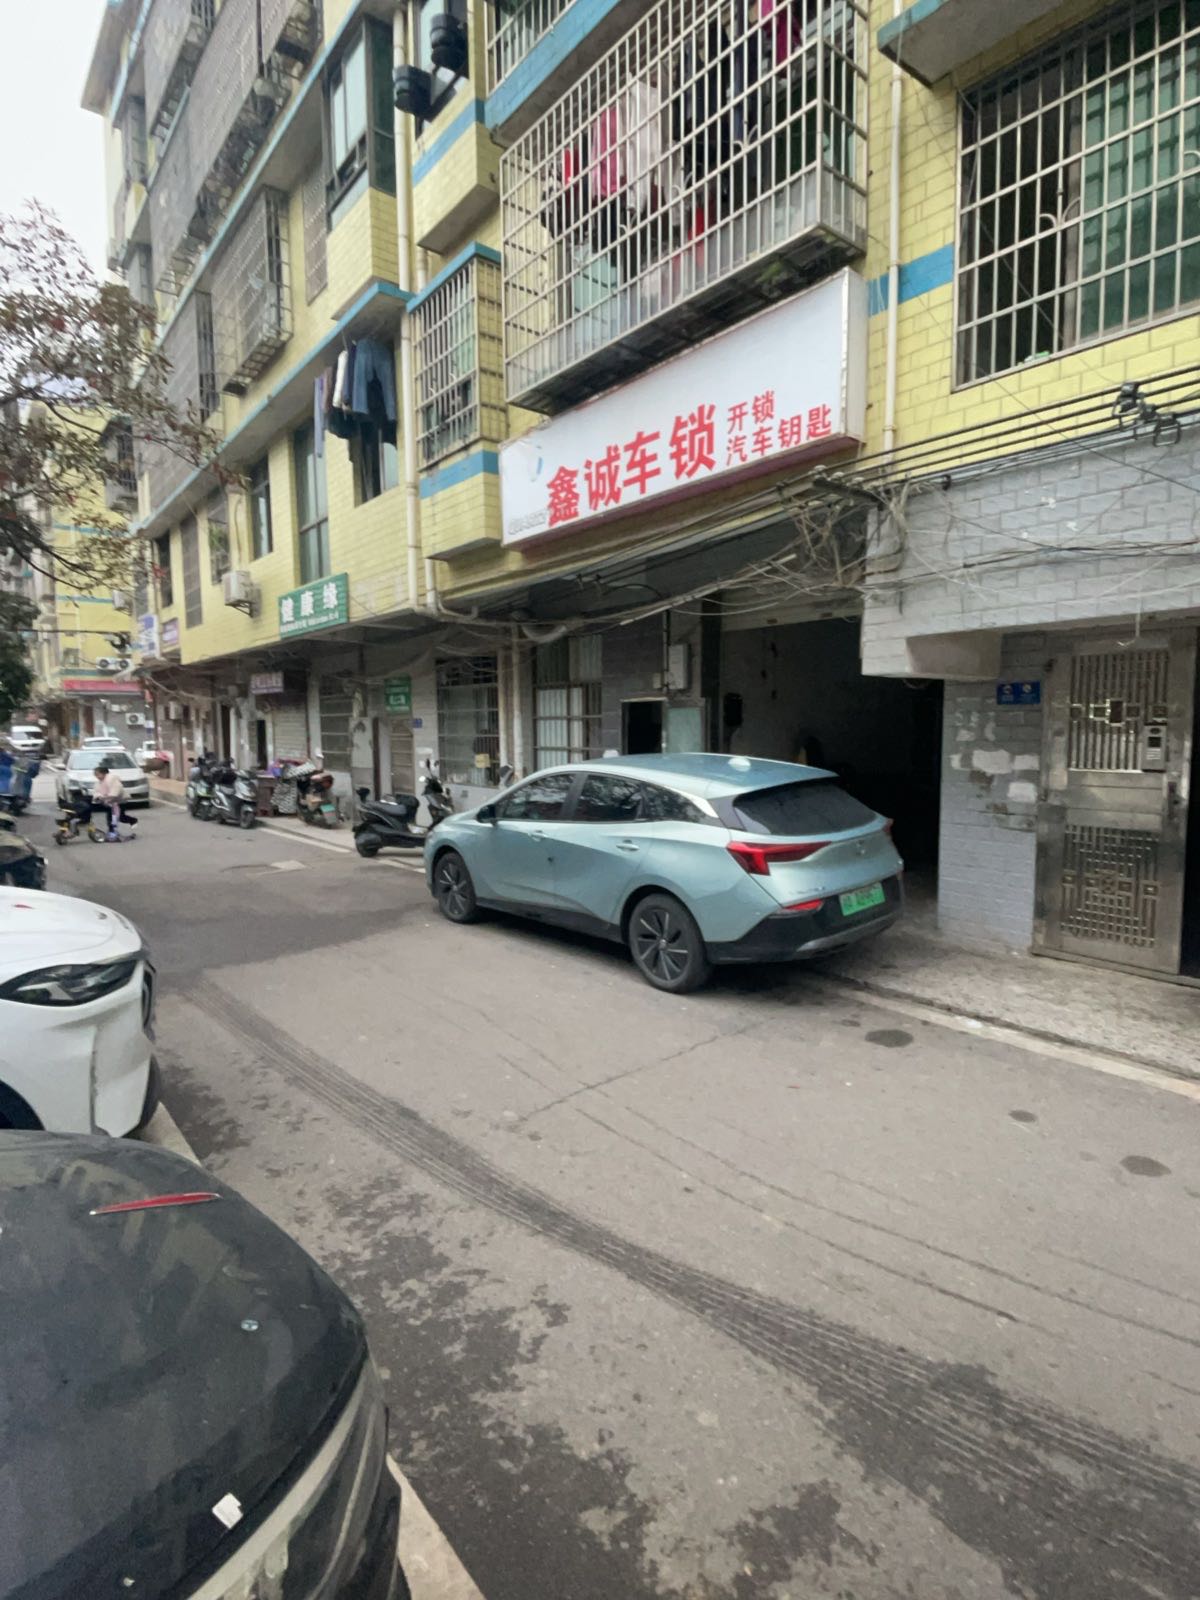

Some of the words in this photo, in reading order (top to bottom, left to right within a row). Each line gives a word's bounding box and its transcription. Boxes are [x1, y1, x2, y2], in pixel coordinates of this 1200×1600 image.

[726, 404, 832, 466] 汽车钥匙
[727, 390, 775, 434] 开锁
[547, 404, 715, 528] 鑫诚车锁
